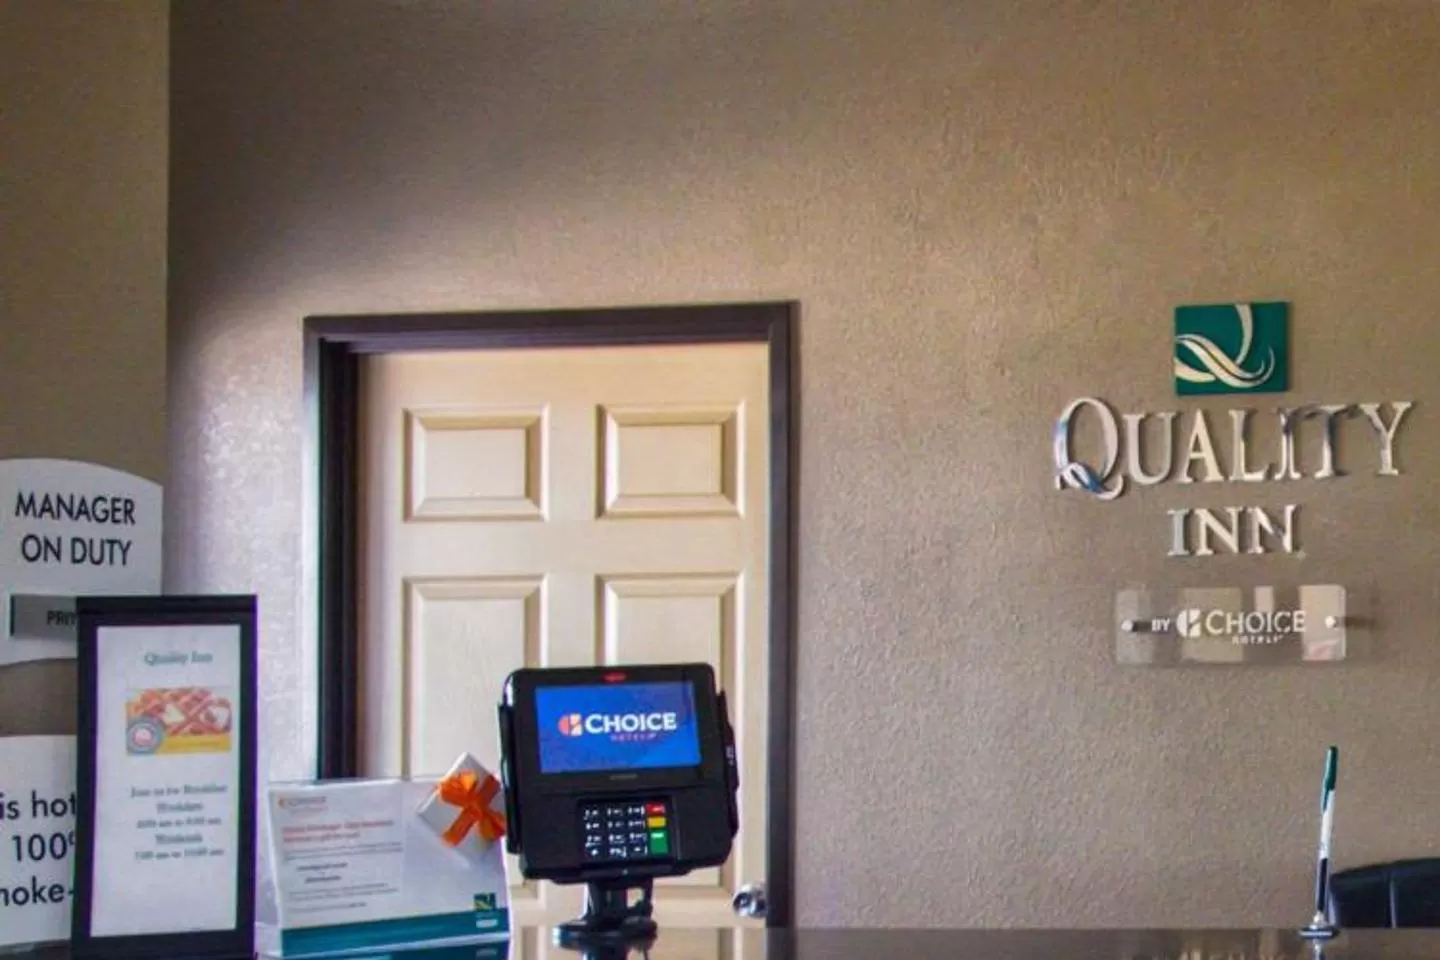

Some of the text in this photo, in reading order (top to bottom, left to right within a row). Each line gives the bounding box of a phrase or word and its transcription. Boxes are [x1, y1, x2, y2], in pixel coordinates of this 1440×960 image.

[1054, 397, 1413, 499] QUALITY
[14, 491, 136, 525] MANAGER
[1167, 504, 1302, 557] INN
[22, 533, 132, 566] ON DUTY
[1151, 608, 1307, 635] BY CHOICE
[585, 712, 677, 734] CHOICE
